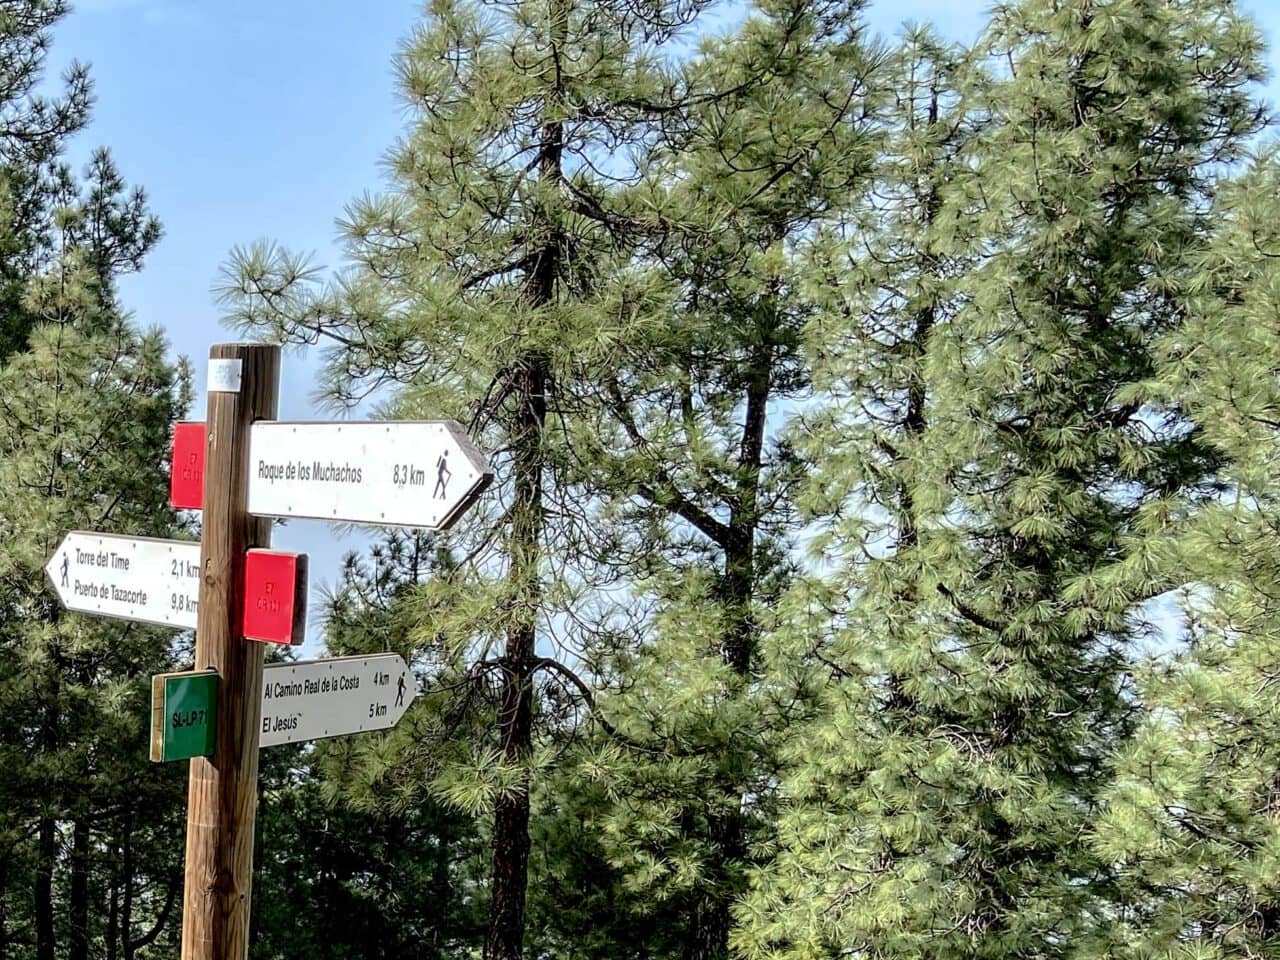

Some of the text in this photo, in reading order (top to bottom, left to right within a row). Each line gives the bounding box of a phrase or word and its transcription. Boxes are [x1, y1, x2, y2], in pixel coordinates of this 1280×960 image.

[258, 460, 425, 487] Roque de los Muchachos 8,3 km
[75, 548, 201, 580] Torre del Time 2,1 km
[74, 580, 98, 599] Puerto
[99, 583, 109, 600] de
[110, 584, 147, 606] Tazacorte
[171, 593, 185, 614] 9,8
[264, 671, 390, 699] Al Camino Real de la Costa 4 km
[172, 709, 198, 728] SL-LP
[262, 716, 271, 733] El
[368, 703, 375, 718] 5
[375, 701, 387, 717] km
